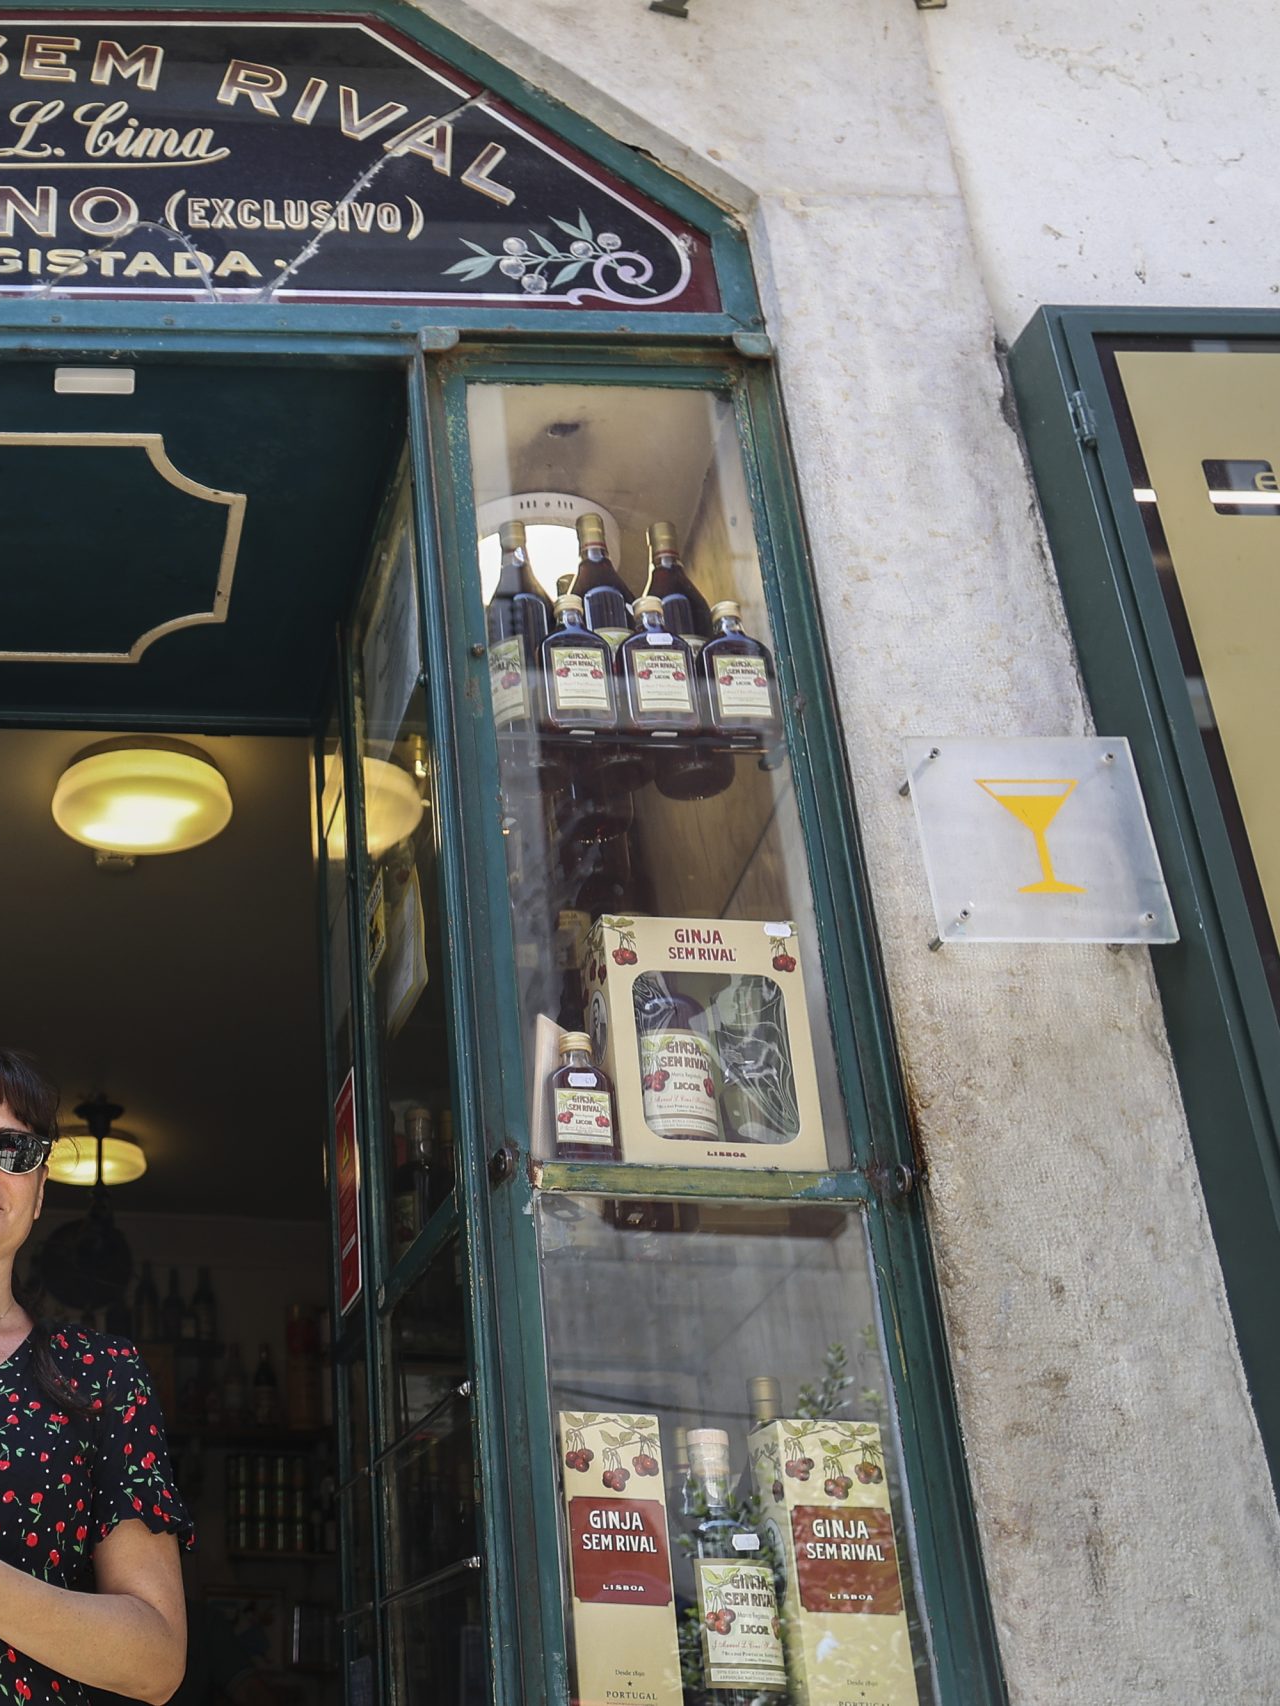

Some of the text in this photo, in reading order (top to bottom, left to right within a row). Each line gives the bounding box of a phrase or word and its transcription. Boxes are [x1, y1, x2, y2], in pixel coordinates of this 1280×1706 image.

[73, 100, 231, 159] Cima
[216, 59, 516, 206] RIVAL
[165, 190, 424, 241] (EXCLUSIVO)
[674, 928, 723, 944] GINJA
[668, 947, 736, 961] SEM RIVAL
[666, 1040, 702, 1056] GINJA
[660, 1056, 709, 1072] SEM RIVAL
[673, 1081, 701, 1091] LICOR
[589, 1510, 644, 1531] GINJA
[812, 1519, 869, 1539] GINJA
[582, 1533, 658, 1553] SEM RIVAL
[806, 1542, 885, 1561] SEM RIVAL
[602, 1584, 645, 1592] LISBOA
[731, 1574, 770, 1591] GINJA
[724, 1592, 749, 1606] SEM
[829, 1593, 874, 1601] LISBOA
[740, 1624, 770, 1635] LICOR
[606, 1690, 658, 1700] PORTUGAL
